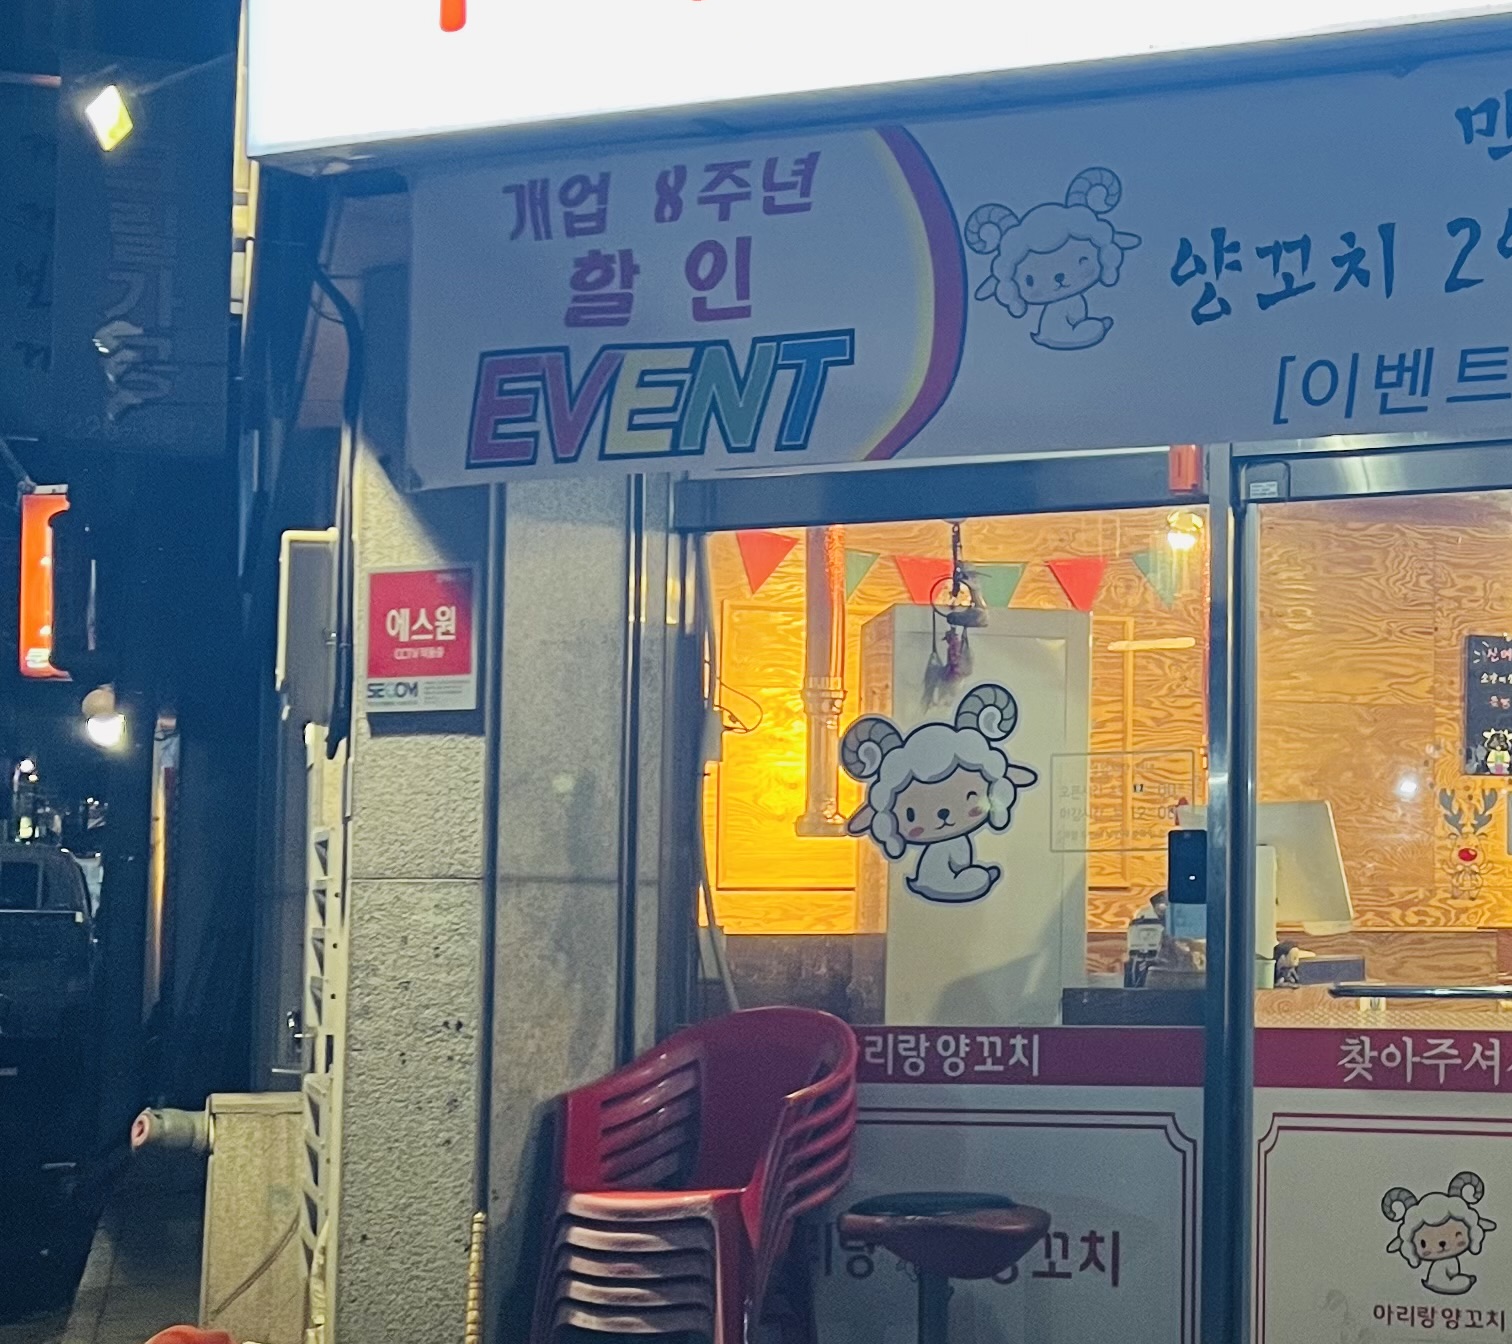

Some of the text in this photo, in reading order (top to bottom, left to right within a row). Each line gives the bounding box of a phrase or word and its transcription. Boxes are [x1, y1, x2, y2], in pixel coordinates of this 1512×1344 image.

[502, 151, 821, 243] 개업 8주년
[1171, 222, 1397, 326] 양꼬치
[465, 327, 855, 469] EVENT
[1272, 345, 1512, 425] [이벤트
[385, 605, 457, 642] 에스원
[367, 681, 419, 699] SECOM
[864, 1033, 1040, 1077] 리랑양꼬치
[990, 1228, 1120, 1289] 꼬치
[1373, 1304, 1506, 1333] 아리랑양꼬치
